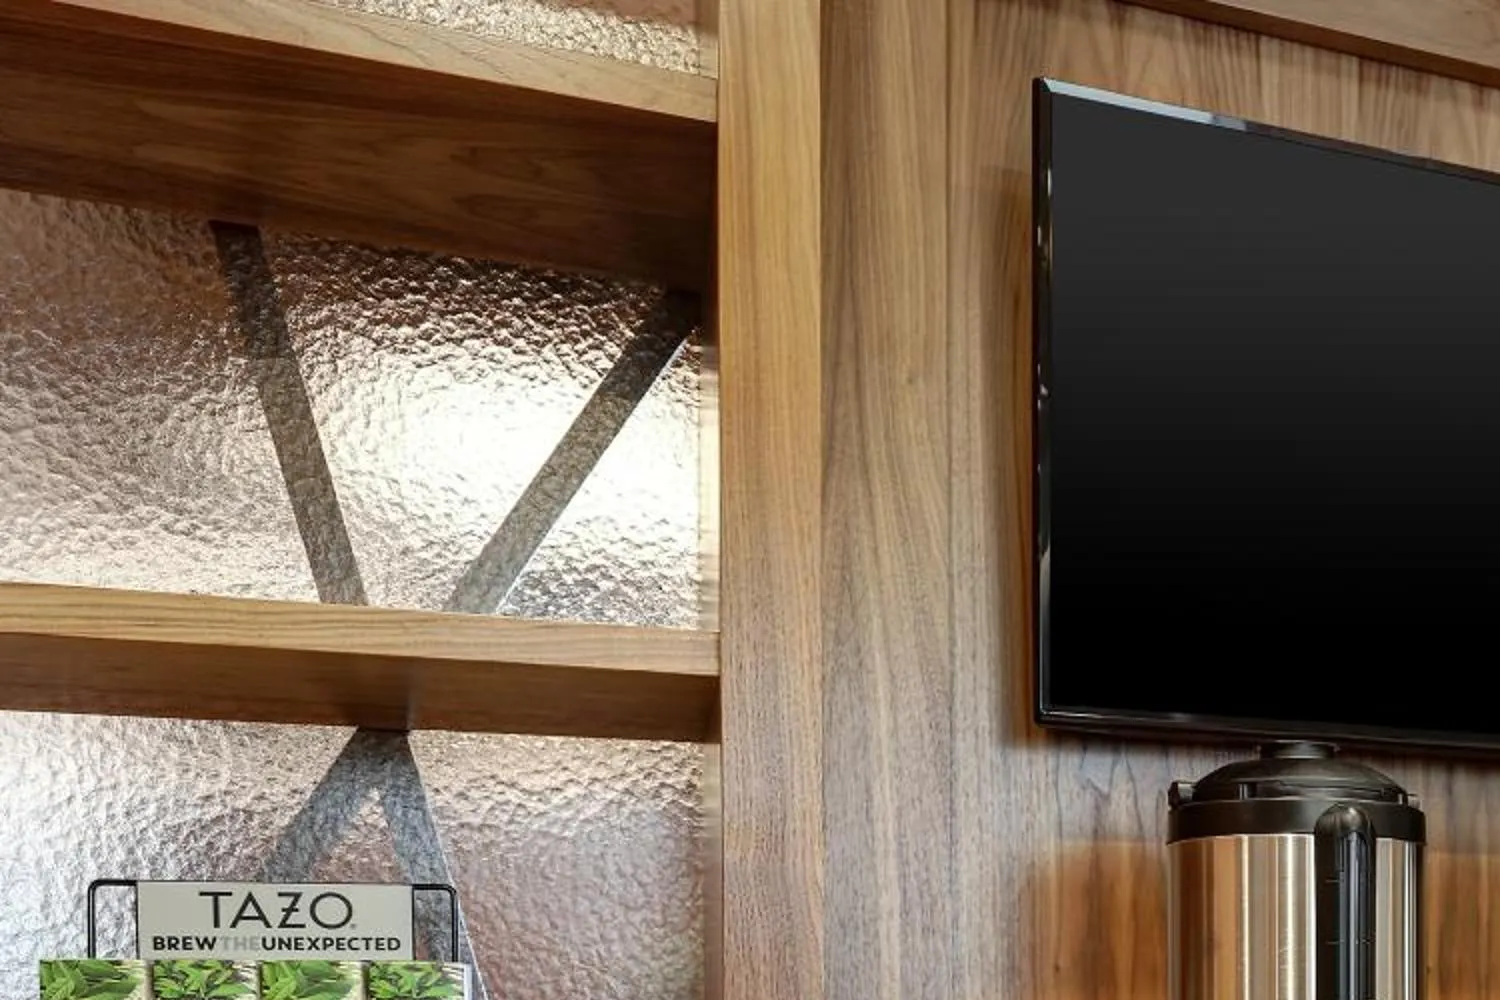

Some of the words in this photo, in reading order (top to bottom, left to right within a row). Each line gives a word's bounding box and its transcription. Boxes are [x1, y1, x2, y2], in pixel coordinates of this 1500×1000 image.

[198, 890, 354, 930] TAZO
[152, 935, 218, 952] BREW
[220, 935, 261, 952] THE
[261, 936, 402, 952] UNEXPECTED
